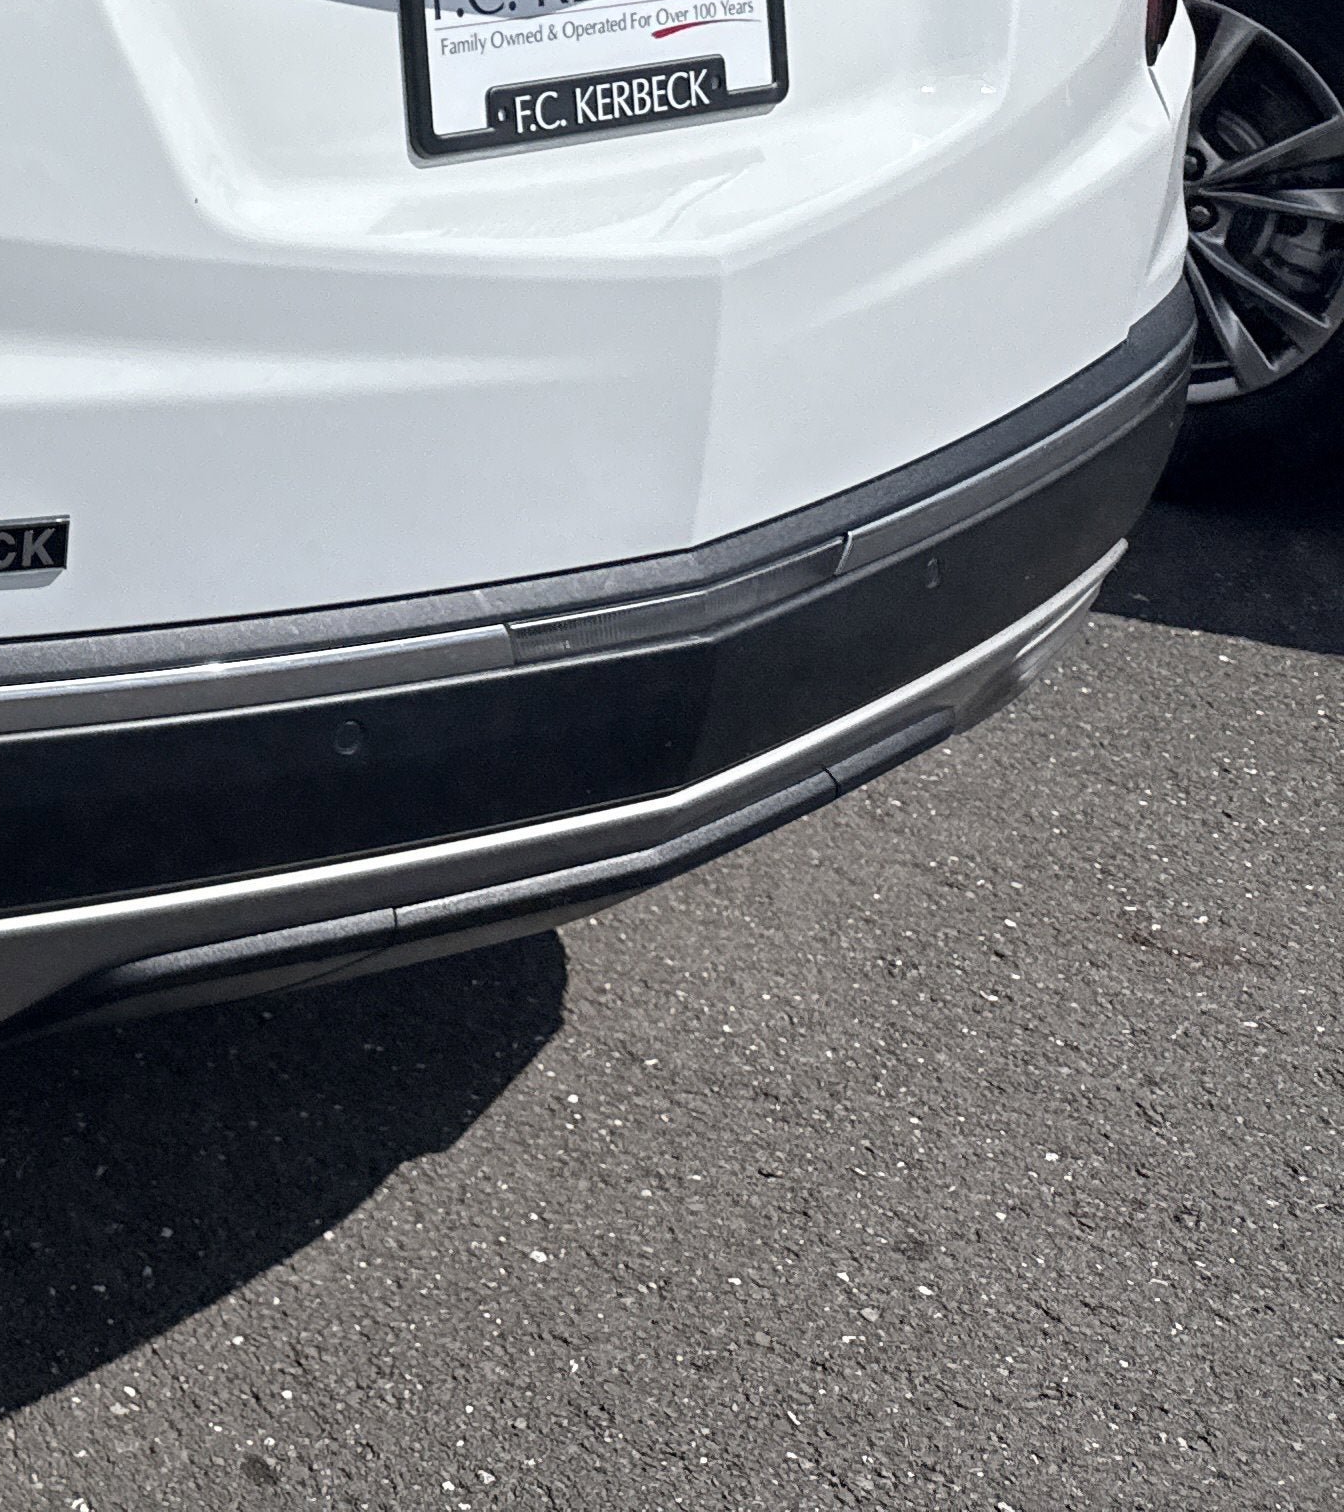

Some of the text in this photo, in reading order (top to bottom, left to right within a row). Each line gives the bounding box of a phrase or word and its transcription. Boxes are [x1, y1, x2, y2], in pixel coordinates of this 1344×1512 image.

[440, 36, 487, 55] Family
[490, 27, 543, 49] Owned
[547, 26, 559, 41] &
[562, 14, 627, 41] Operated
[630, 10, 652, 28] For
[656, 6, 688, 25] Over
[693, 1, 717, 21] 100
[513, 68, 711, 134] F.C. KERBECK
